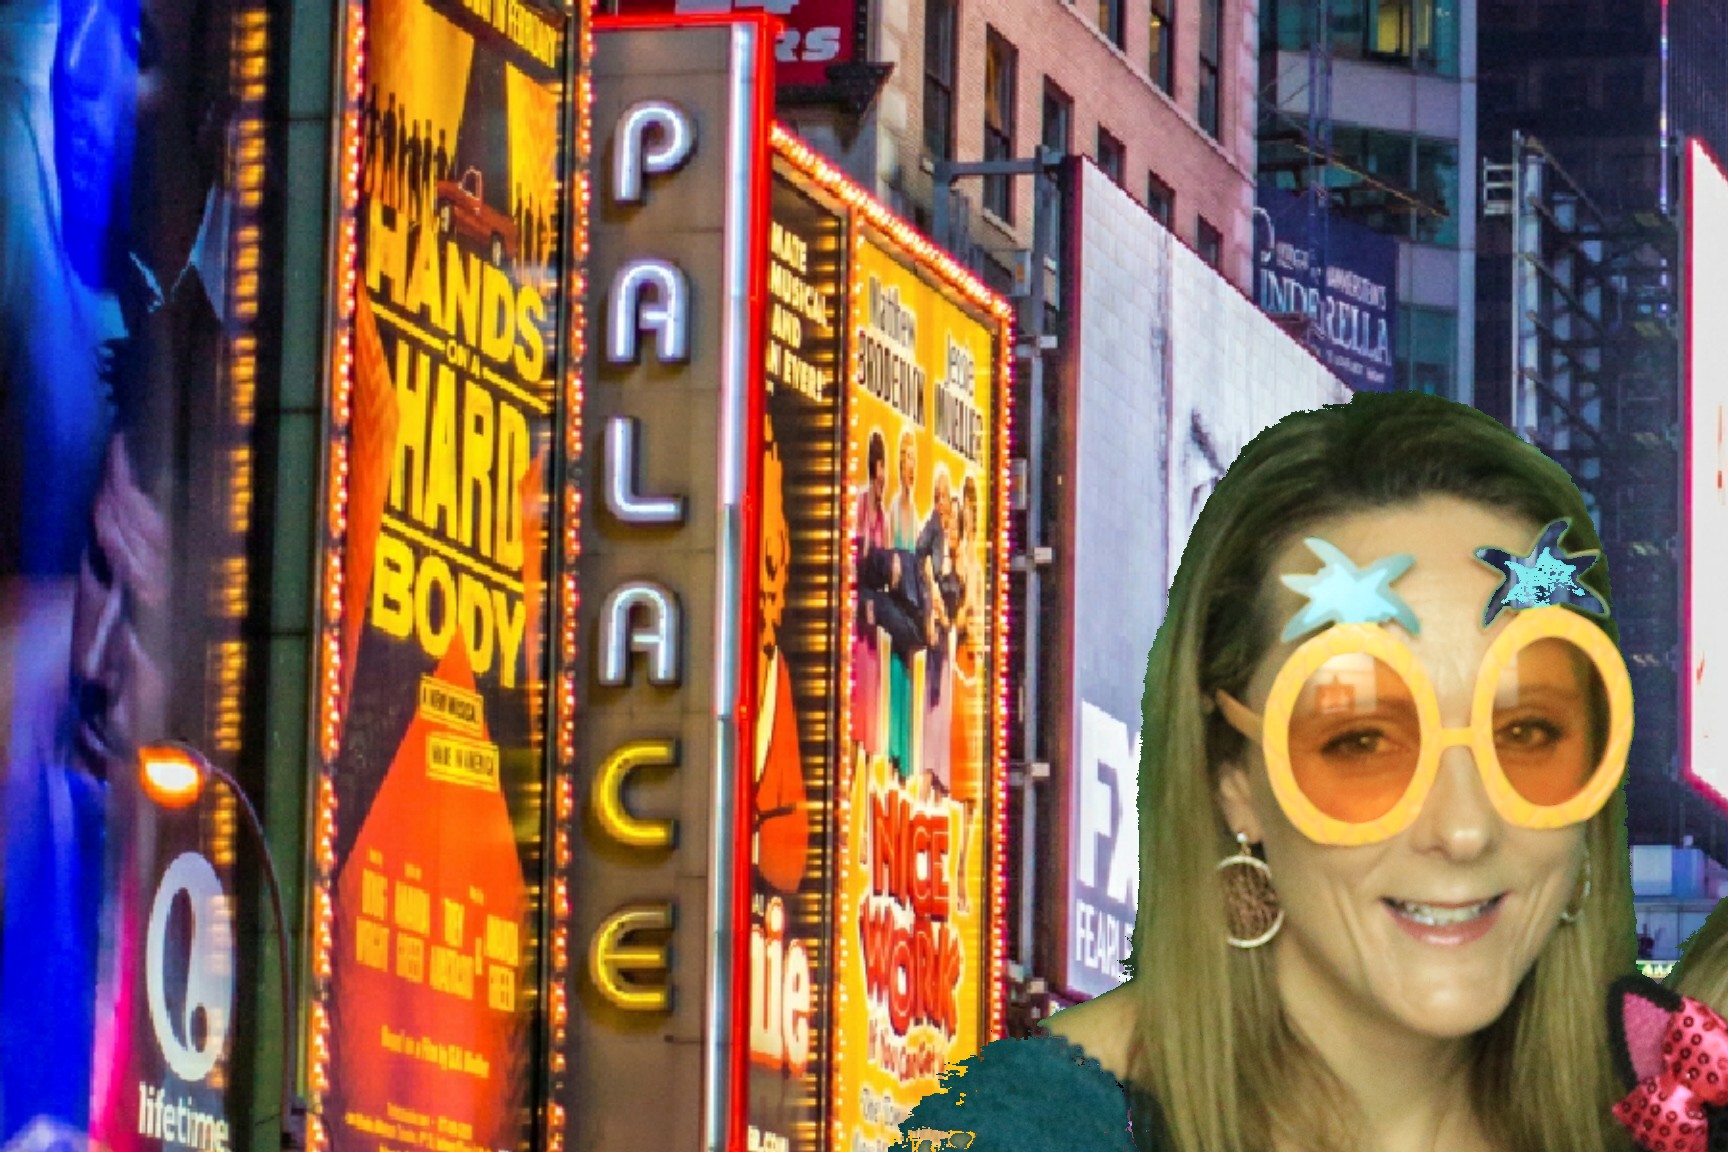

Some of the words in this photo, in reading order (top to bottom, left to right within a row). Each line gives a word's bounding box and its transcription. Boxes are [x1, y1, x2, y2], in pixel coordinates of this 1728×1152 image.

[366, 200, 545, 383] HANDS
[392, 337, 531, 569] HARD
[371, 534, 526, 690] BODY
[590, 98, 695, 1012] PALACE
[871, 788, 950, 923] NICE
[859, 898, 962, 1038] WORK
